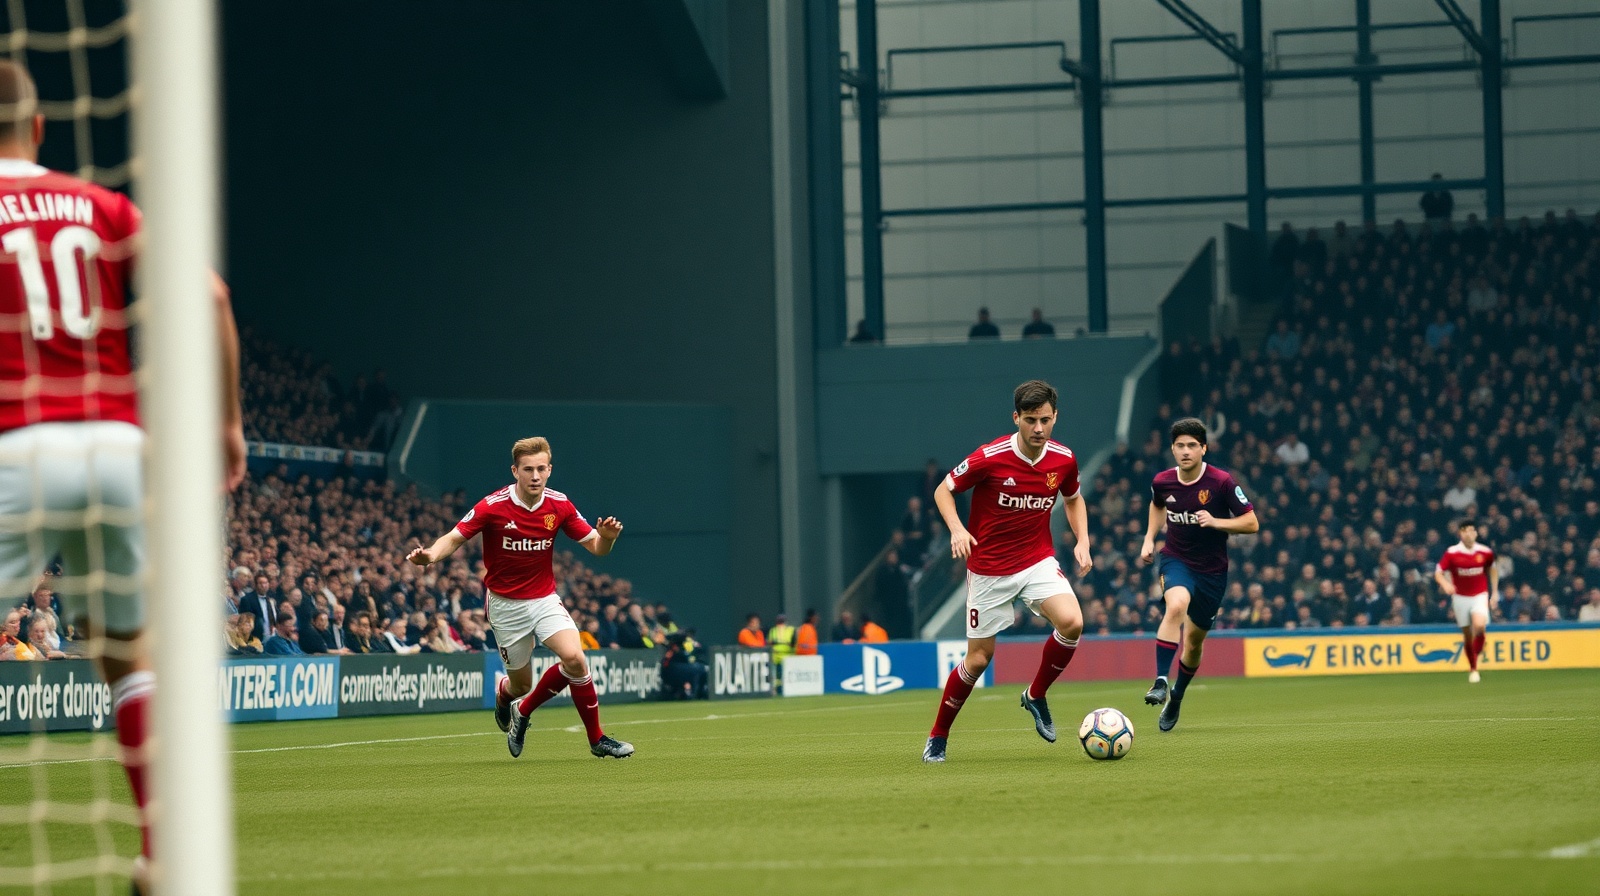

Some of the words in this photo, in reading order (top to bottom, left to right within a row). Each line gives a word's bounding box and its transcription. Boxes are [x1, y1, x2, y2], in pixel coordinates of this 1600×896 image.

[2, 225, 102, 340] 10
[969, 608, 979, 629] 8
[1326, 643, 1401, 667] EIRCH
[17, 673, 61, 720] orter
